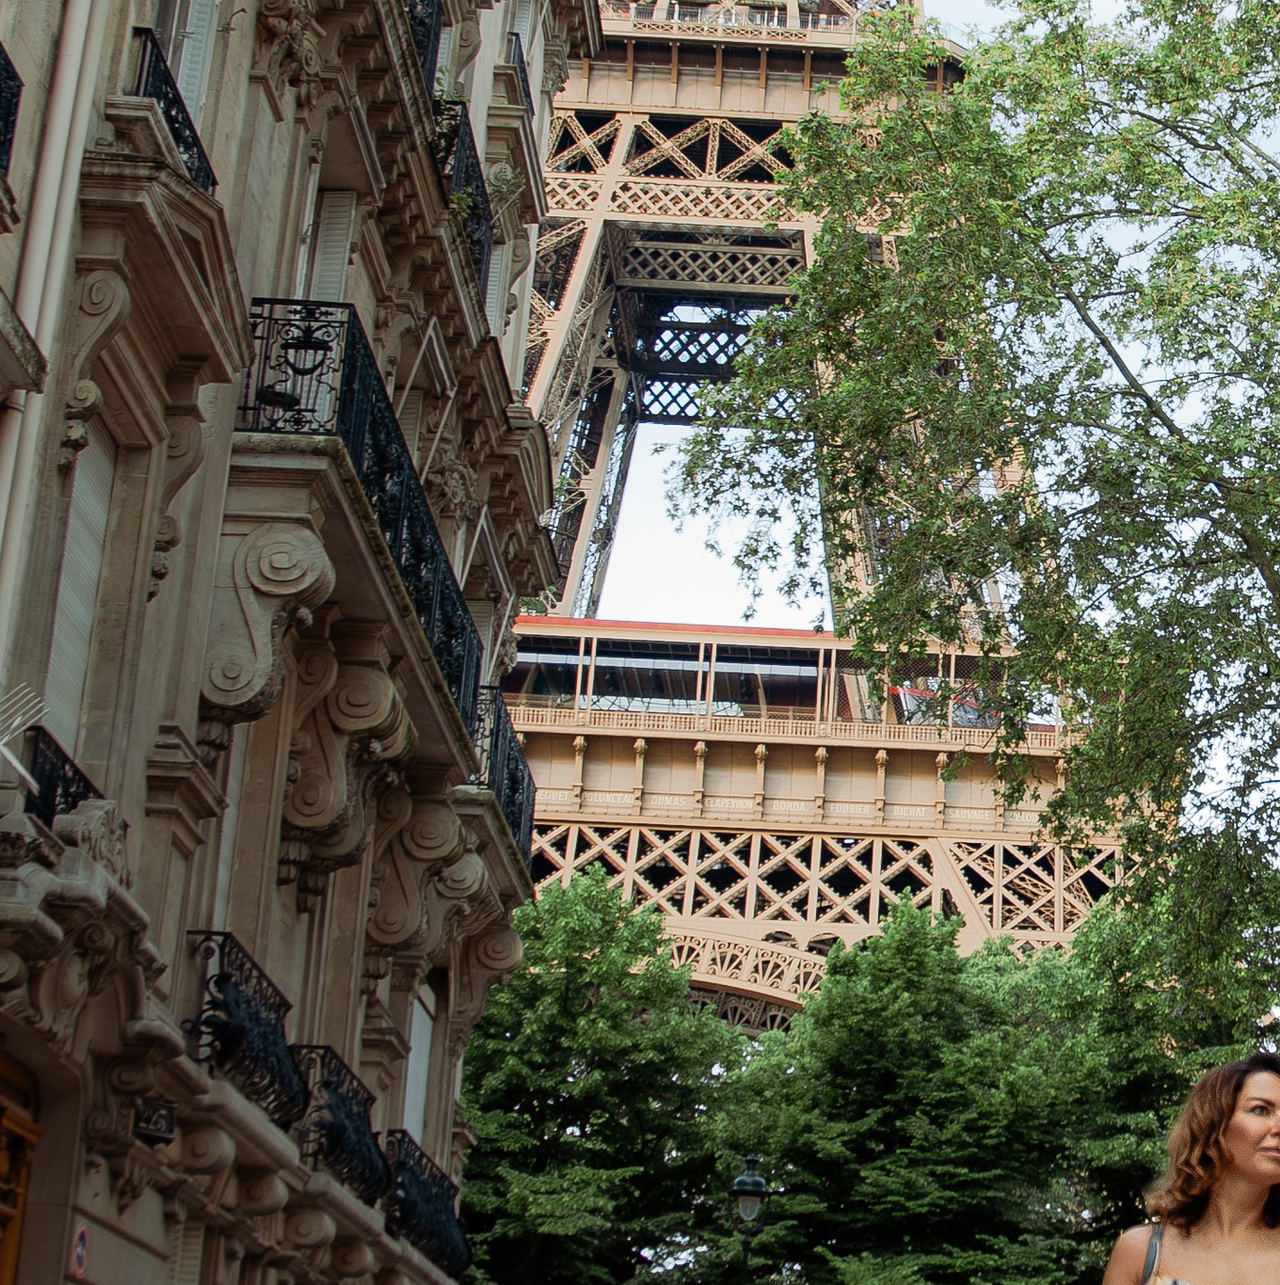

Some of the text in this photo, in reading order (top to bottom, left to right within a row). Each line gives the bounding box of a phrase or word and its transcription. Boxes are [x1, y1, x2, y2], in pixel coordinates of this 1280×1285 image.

[535, 790, 570, 801] EGUET
[581, 792, 634, 804] POLONCEAU
[651, 795, 686, 807] DUMAS
[705, 798, 752, 809] CLAPEYRON
[773, 801, 805, 812] BORDA
[830, 804, 870, 815] FOURIER
[893, 806, 926, 817] BICHAT
[949, 809, 990, 820] SAUVAGE
